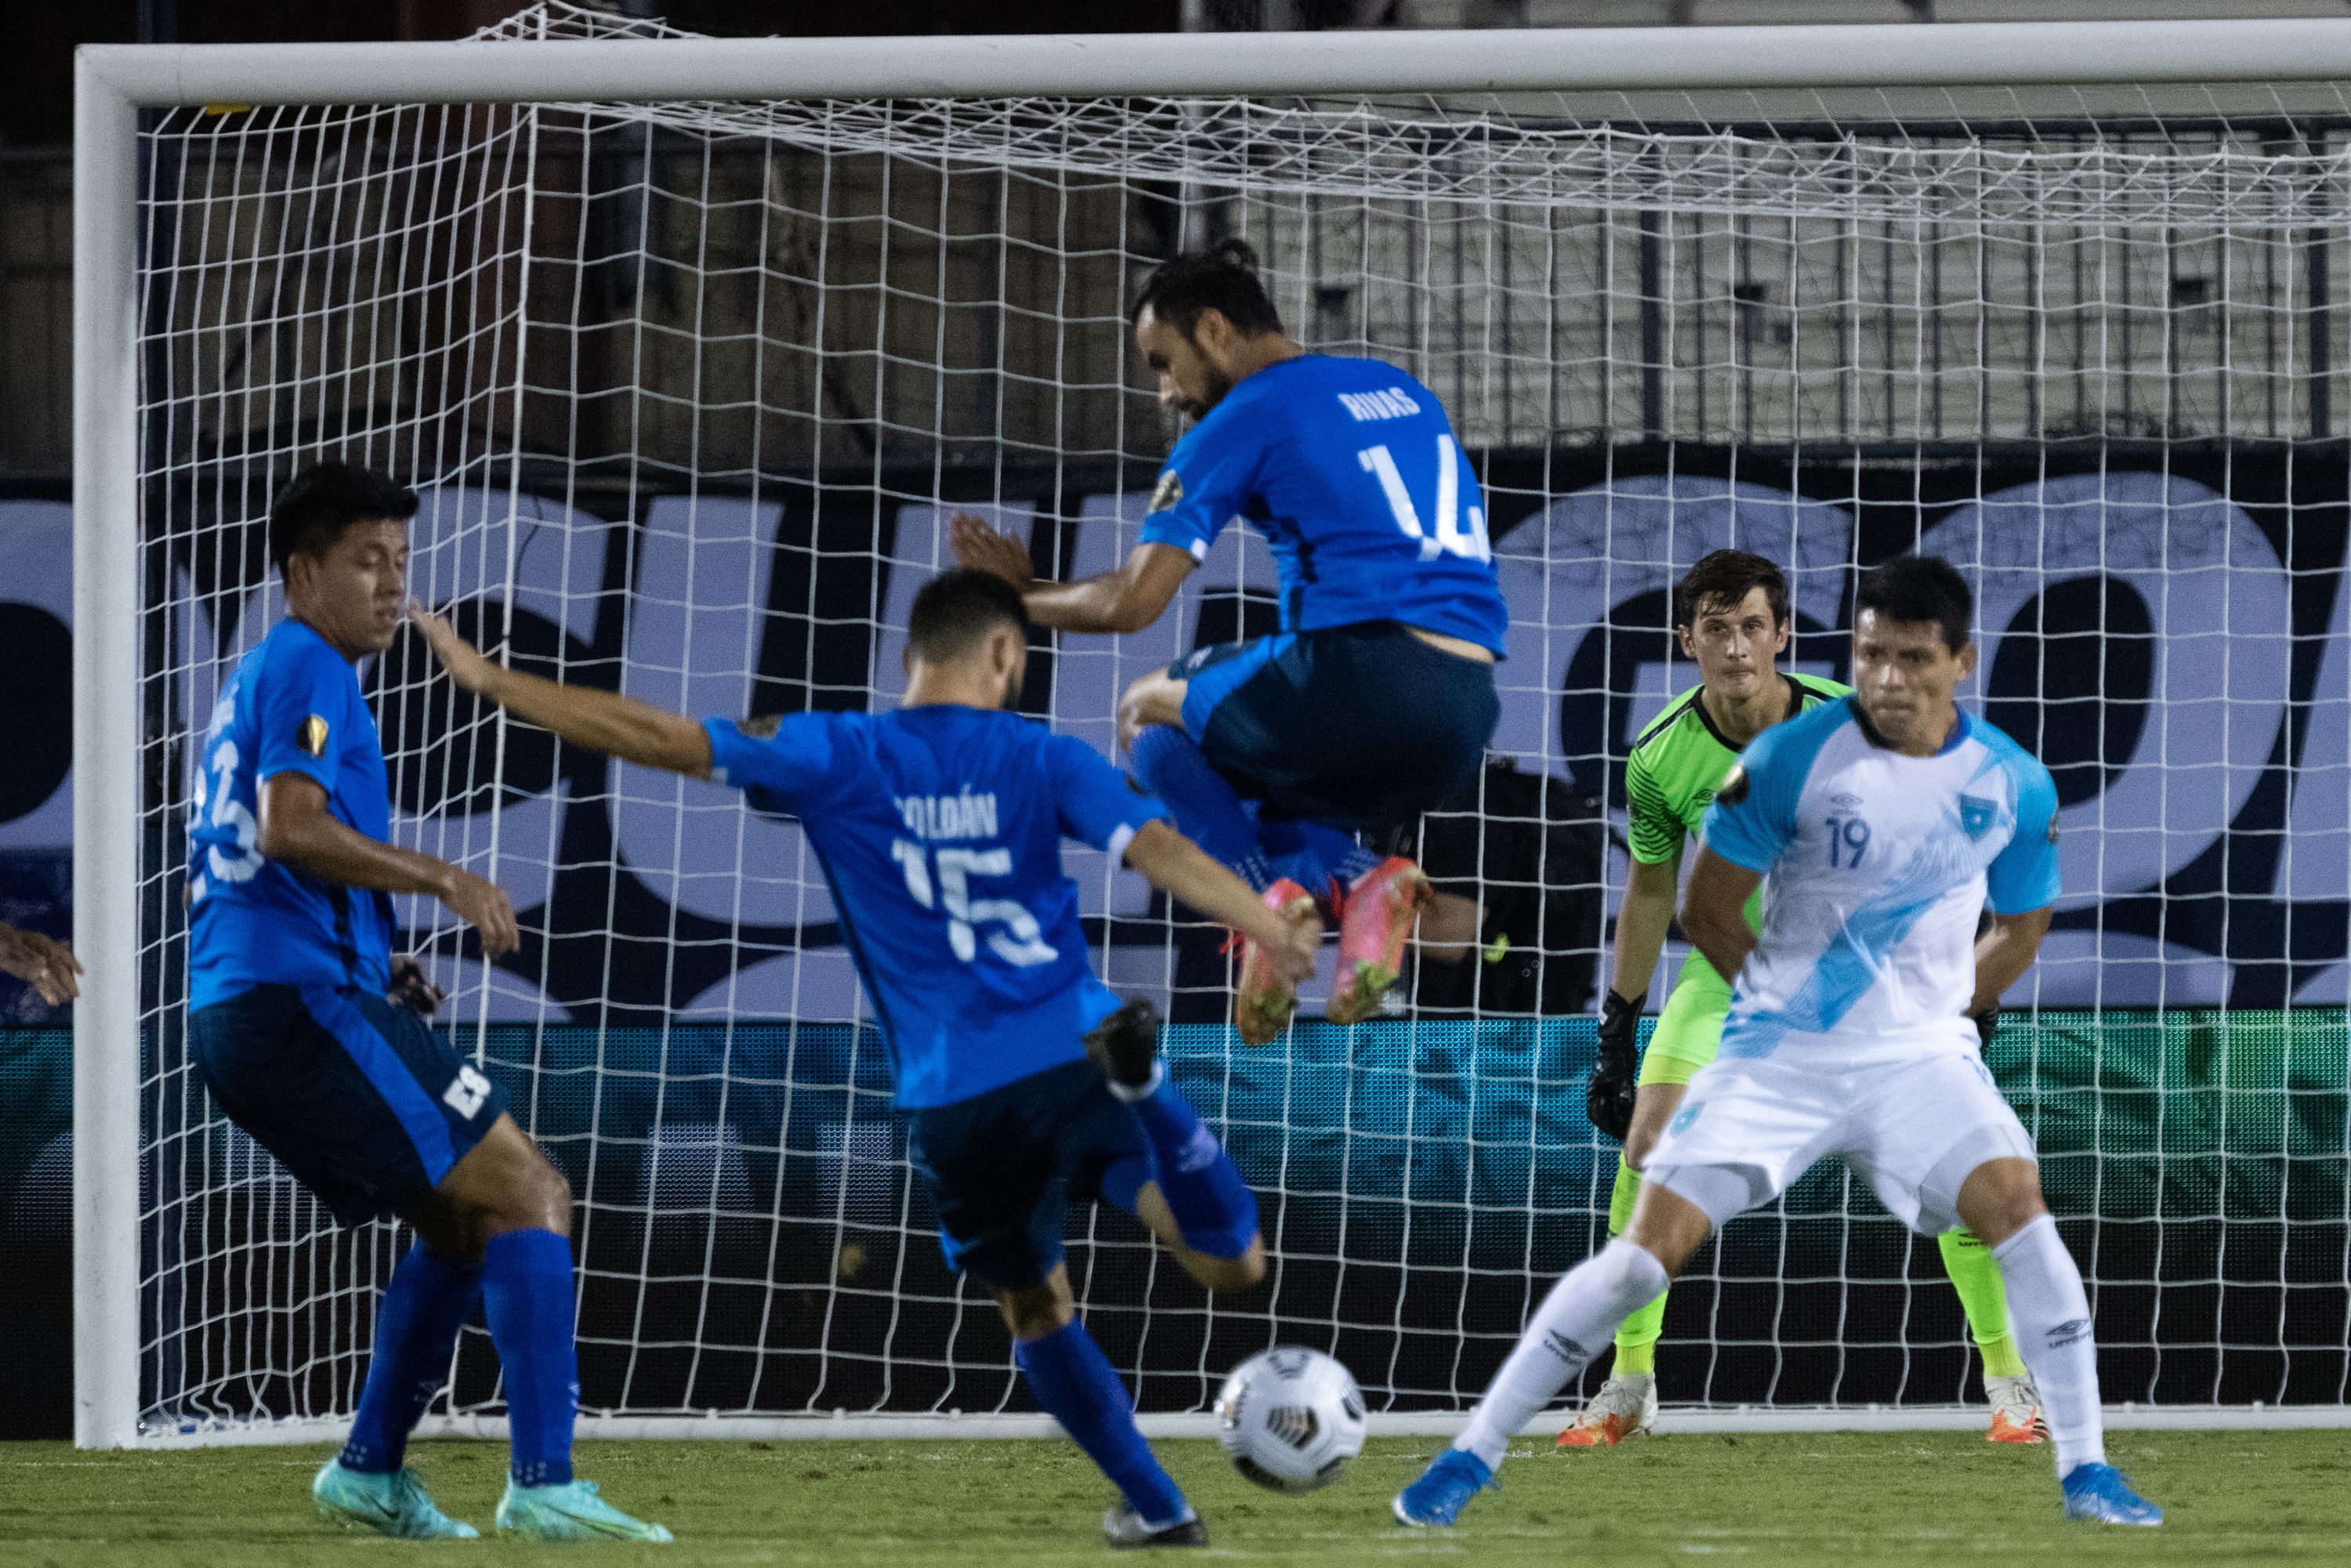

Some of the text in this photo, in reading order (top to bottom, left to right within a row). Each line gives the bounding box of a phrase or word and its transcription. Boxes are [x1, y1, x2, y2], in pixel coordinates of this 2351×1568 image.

[1337, 387, 1421, 422] RIVAS
[1357, 433, 1492, 566] 14
[892, 783, 998, 840] OLDÁN
[1825, 817, 1872, 870] 19
[891, 836, 1059, 967] 15
